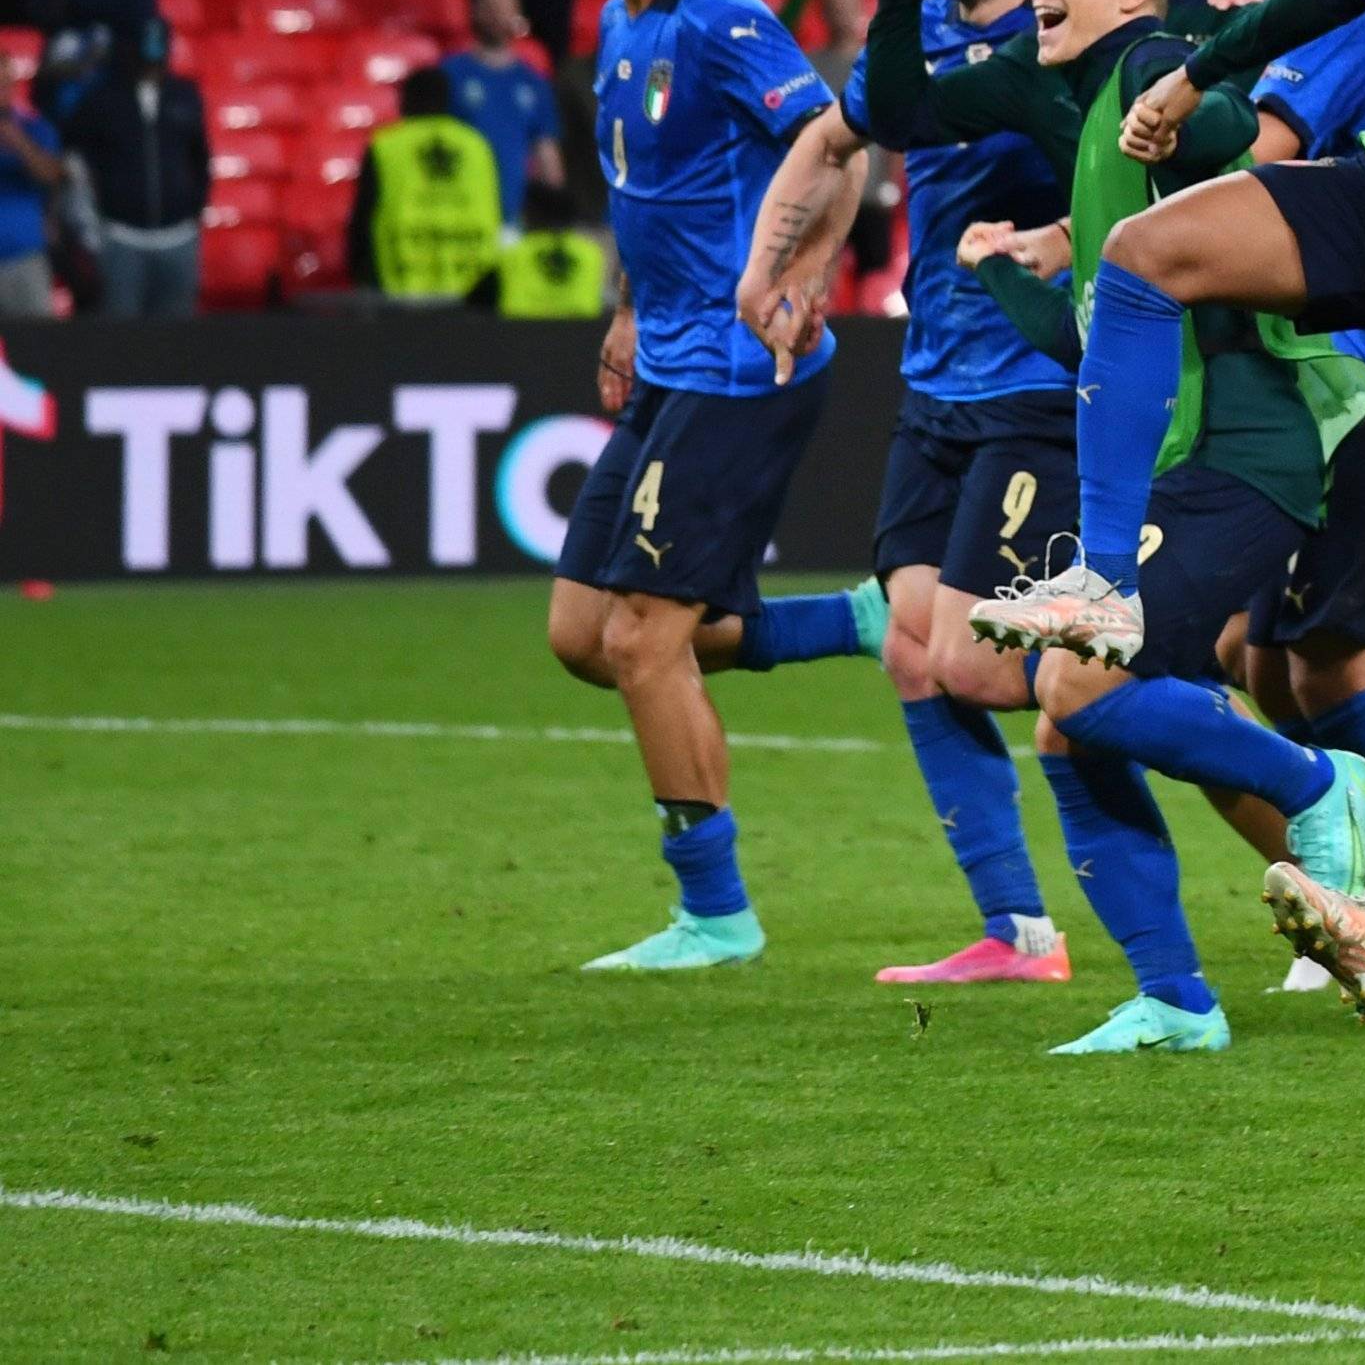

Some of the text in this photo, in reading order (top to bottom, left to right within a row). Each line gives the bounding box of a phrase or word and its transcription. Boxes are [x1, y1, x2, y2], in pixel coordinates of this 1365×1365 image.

[84, 383, 778, 568] TikTo
[632, 460, 665, 532] 4
[1000, 471, 1037, 540] 9
